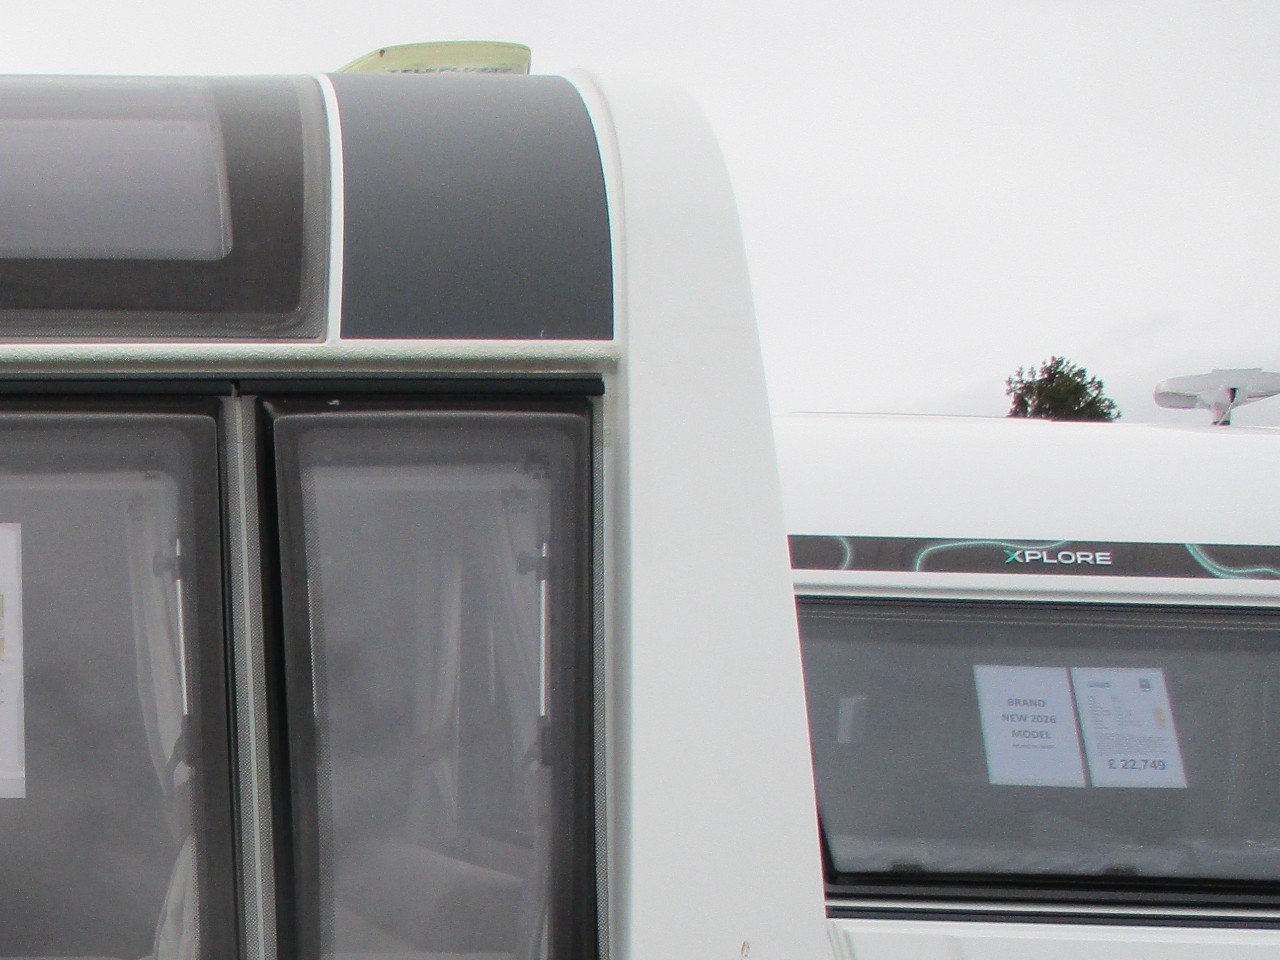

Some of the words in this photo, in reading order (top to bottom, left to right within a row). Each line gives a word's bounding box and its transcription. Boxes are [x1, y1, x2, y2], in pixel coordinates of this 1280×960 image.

[1003, 549, 1112, 566] XPLORE
[1007, 698, 1046, 707] BRAND
[1001, 713, 1028, 722] NEW
[1011, 730, 1052, 739] MODEL
